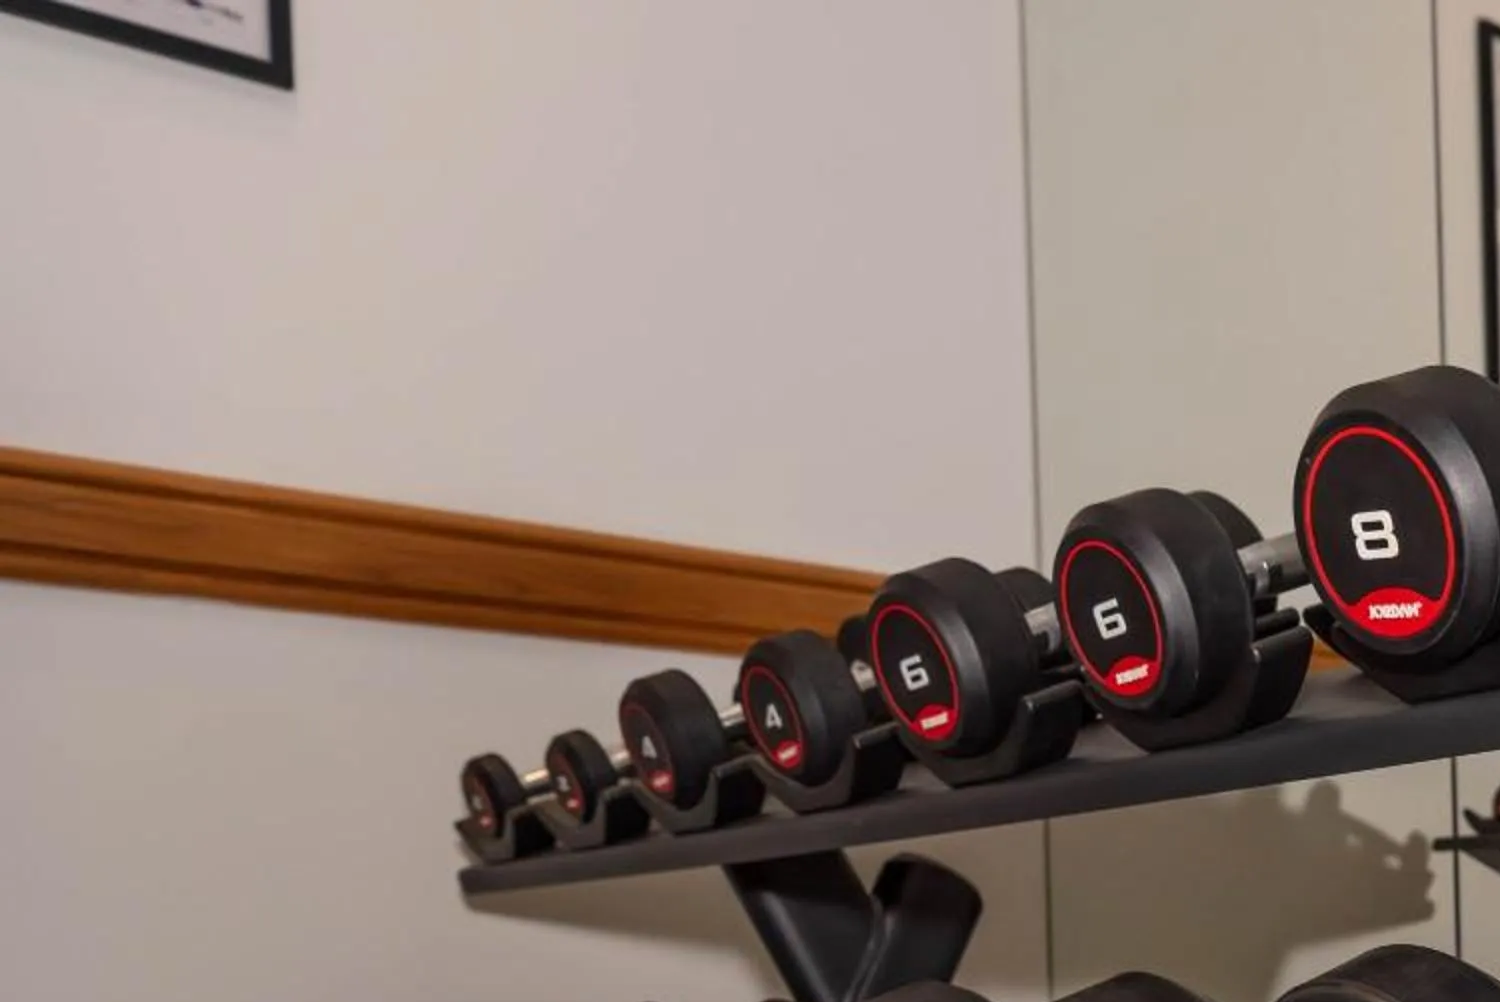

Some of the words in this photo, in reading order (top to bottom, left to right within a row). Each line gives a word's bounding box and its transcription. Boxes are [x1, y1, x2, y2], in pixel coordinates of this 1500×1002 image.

[1351, 509, 1400, 561] 8
[1093, 597, 1127, 640] 6
[899, 653, 929, 691] 6
